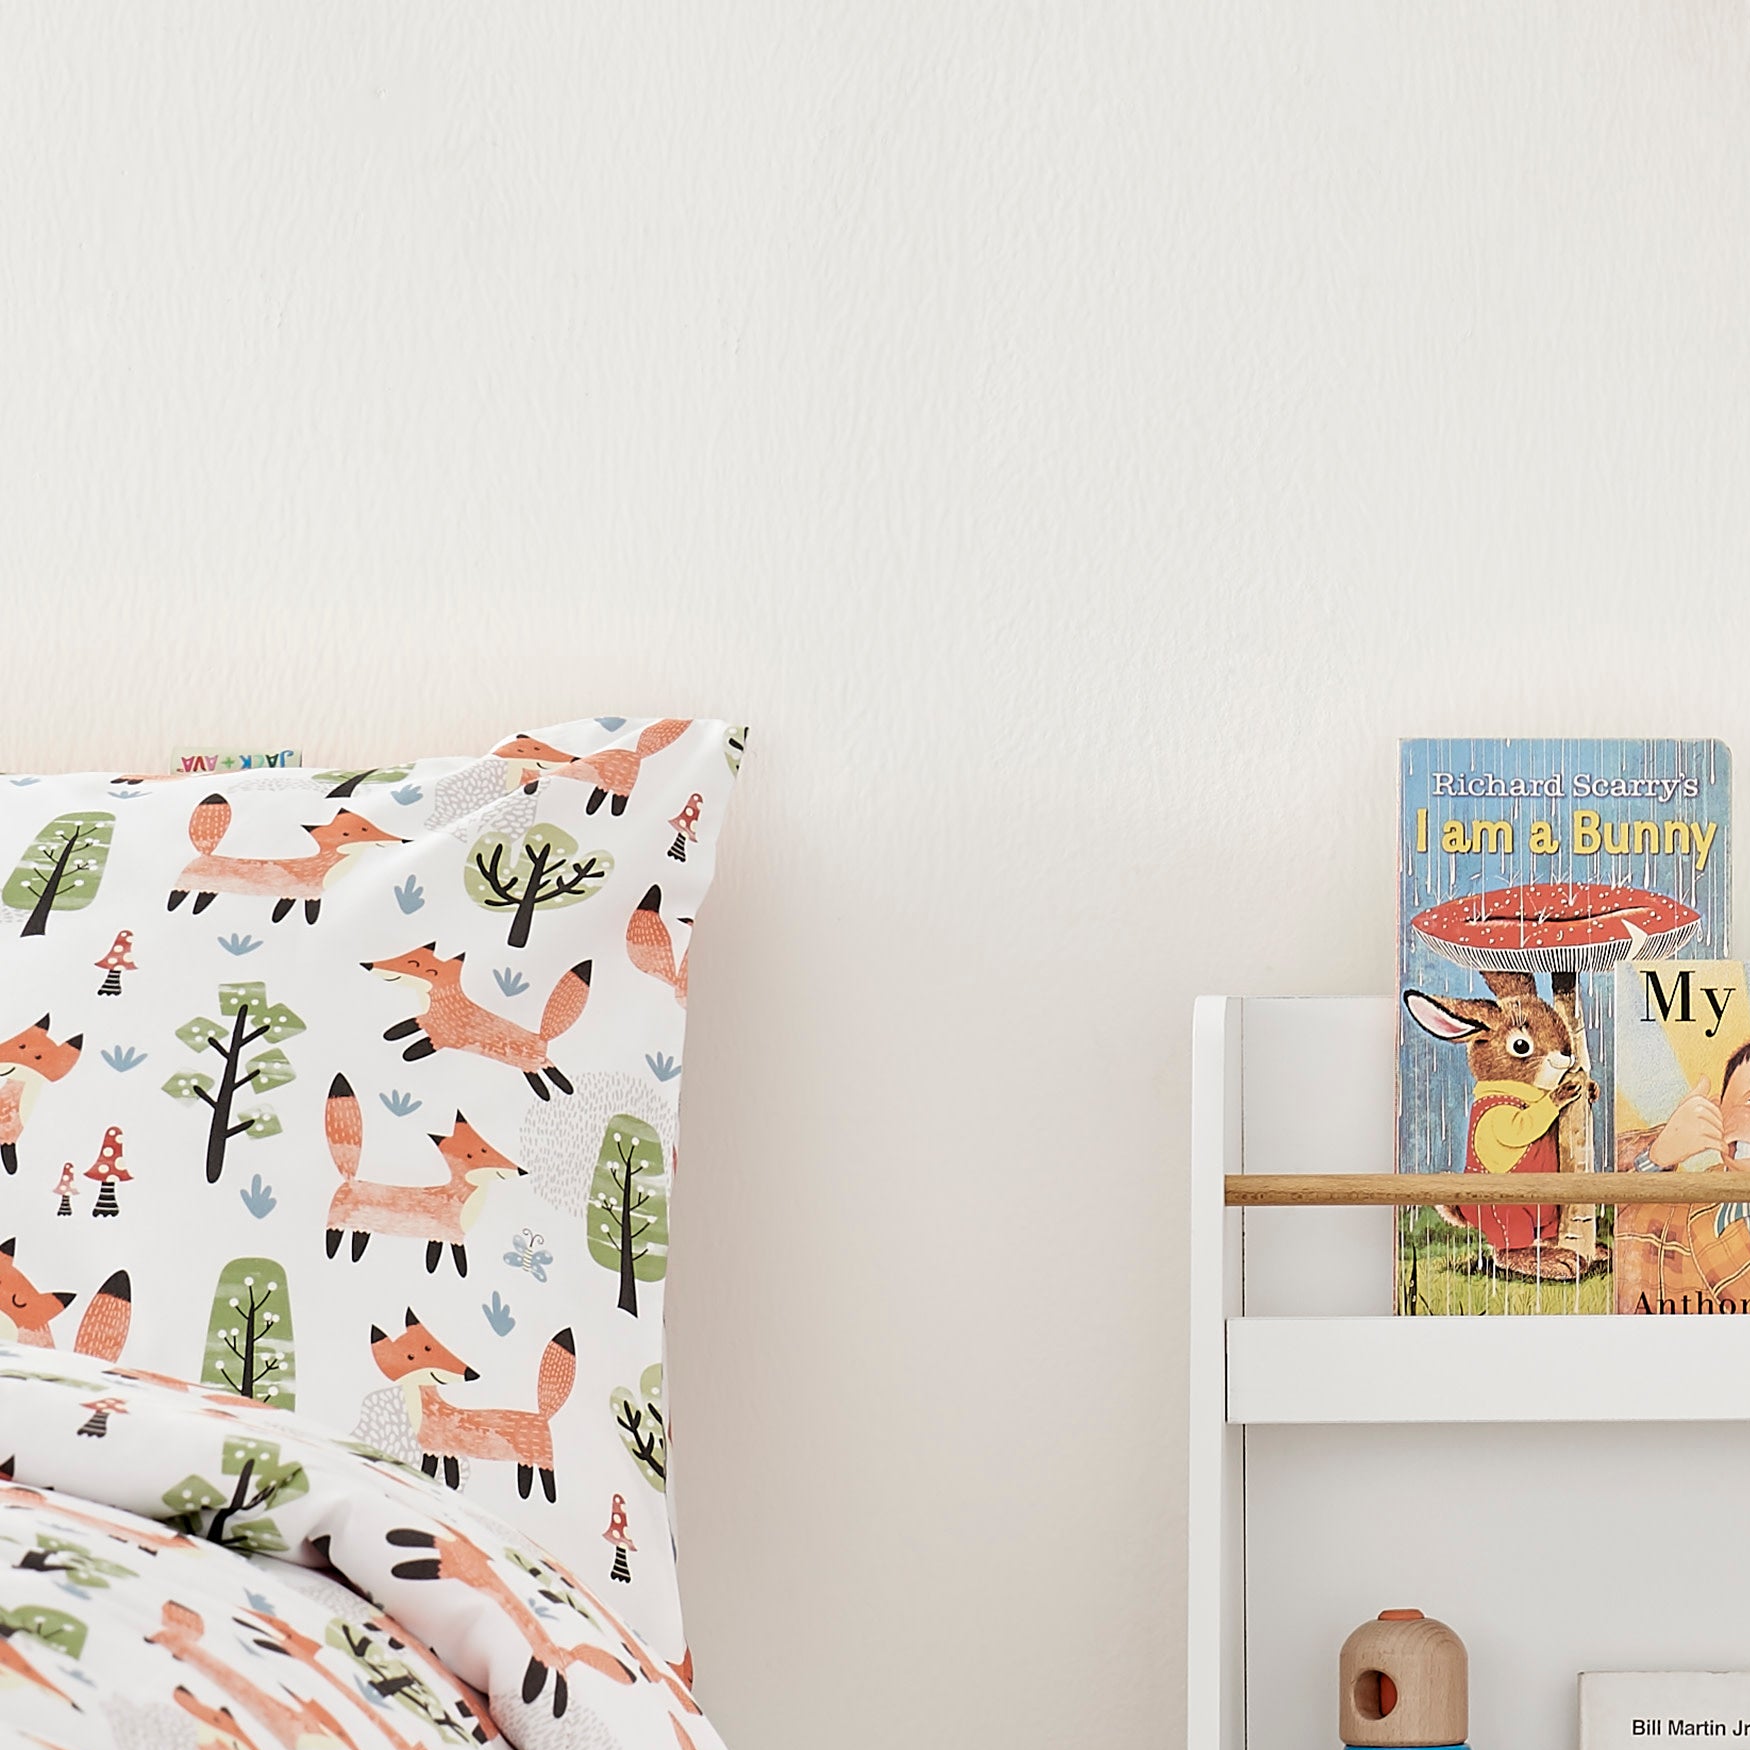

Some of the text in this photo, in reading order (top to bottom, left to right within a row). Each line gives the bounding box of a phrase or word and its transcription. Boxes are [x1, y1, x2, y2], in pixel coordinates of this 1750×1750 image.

[1432, 772, 1698, 802] Richard Scarry's
[1416, 808, 1718, 871] I am a Bunny
[1640, 970, 1737, 1038] My
[1632, 1719, 1661, 1736] Bill
[1668, 1719, 1726, 1736] Martin
[1732, 1719, 1750, 1736] Jr
